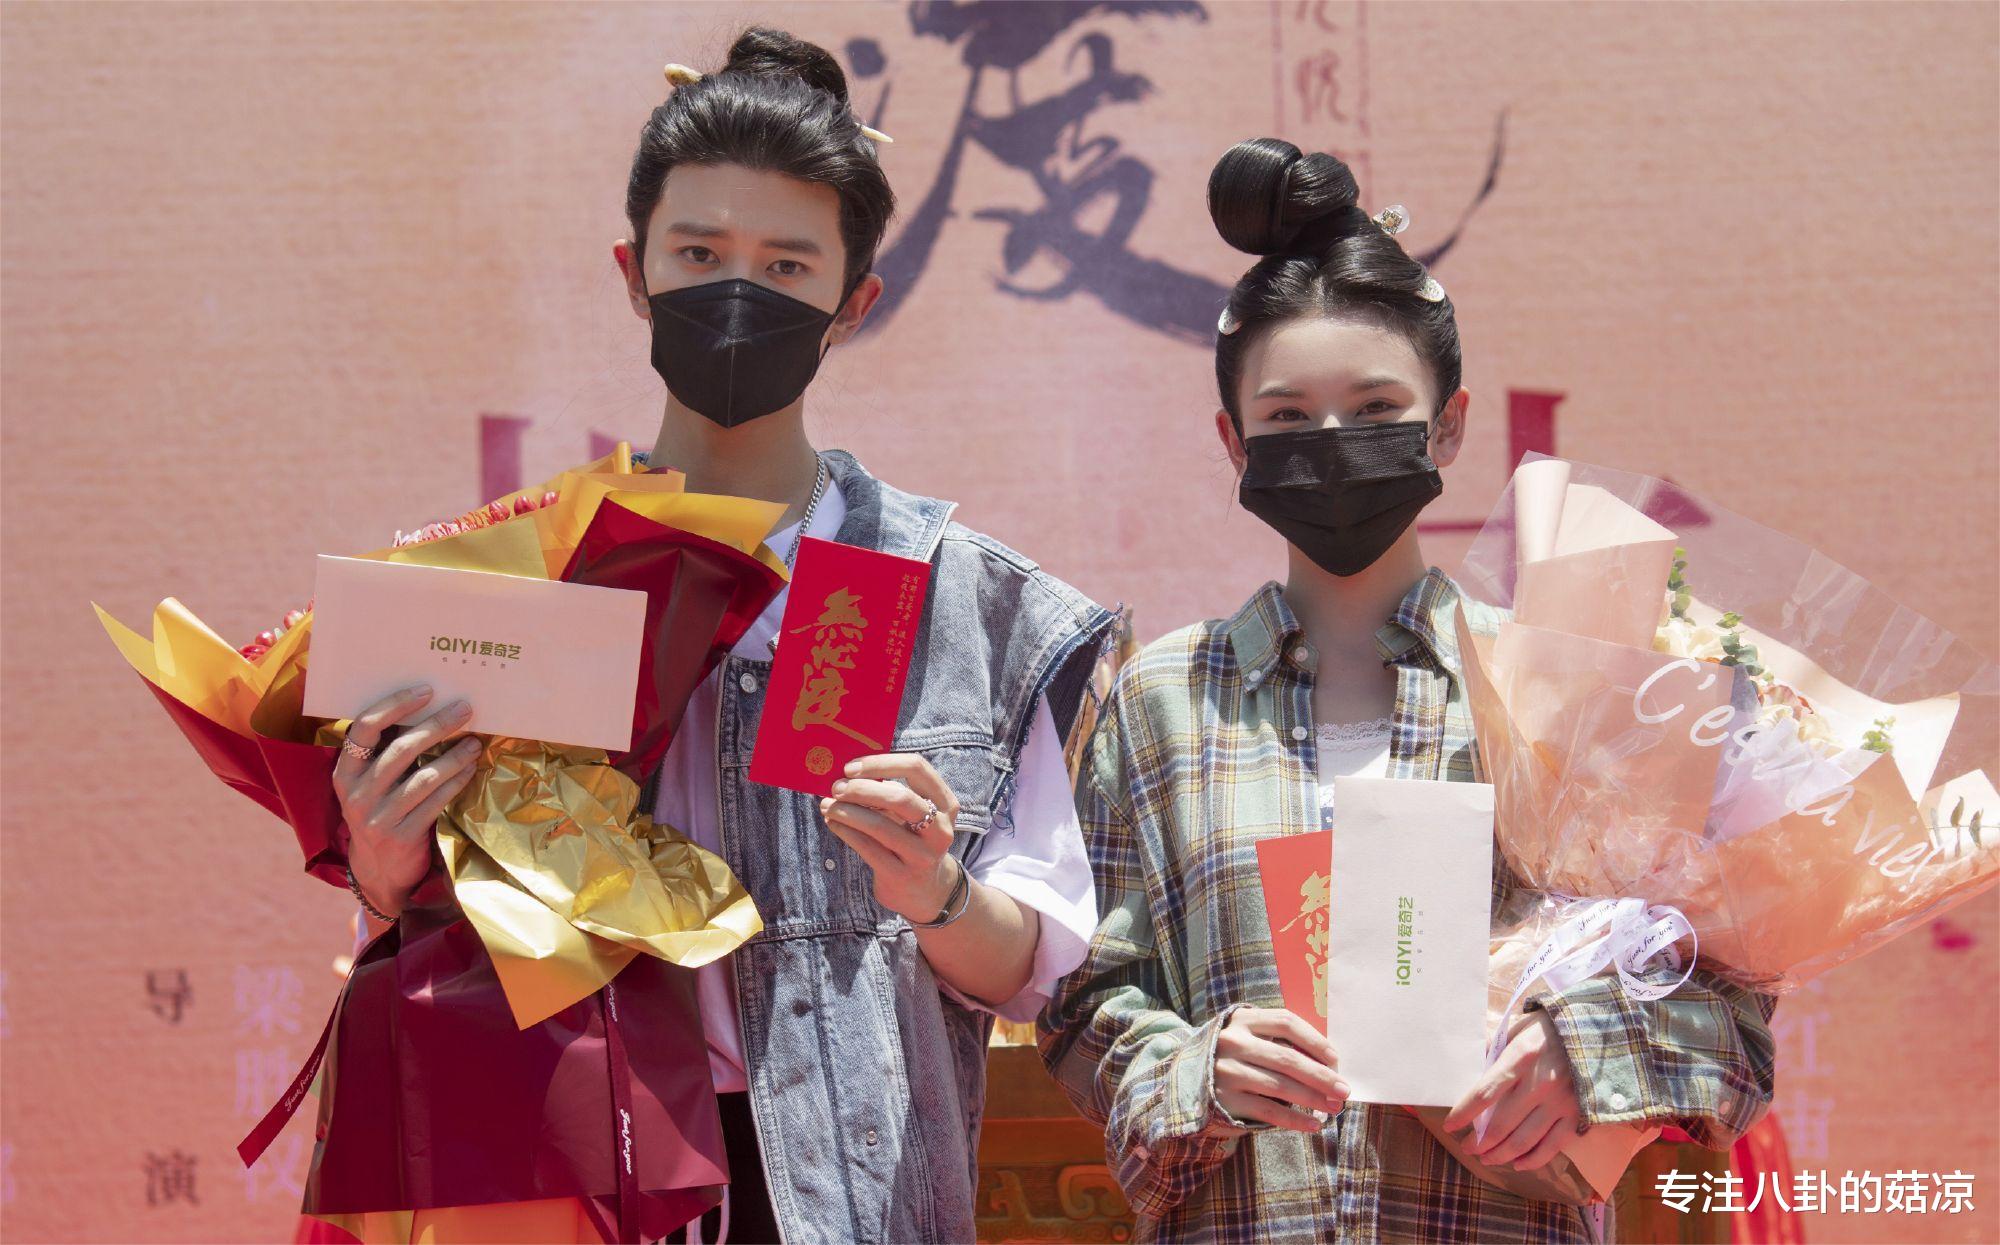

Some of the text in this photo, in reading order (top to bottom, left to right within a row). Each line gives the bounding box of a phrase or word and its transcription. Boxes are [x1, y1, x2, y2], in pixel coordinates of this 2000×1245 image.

[430, 636, 522, 660] iQIYI 爱奇艺
[1396, 896, 1414, 986] iQIYI 爱奇艺
